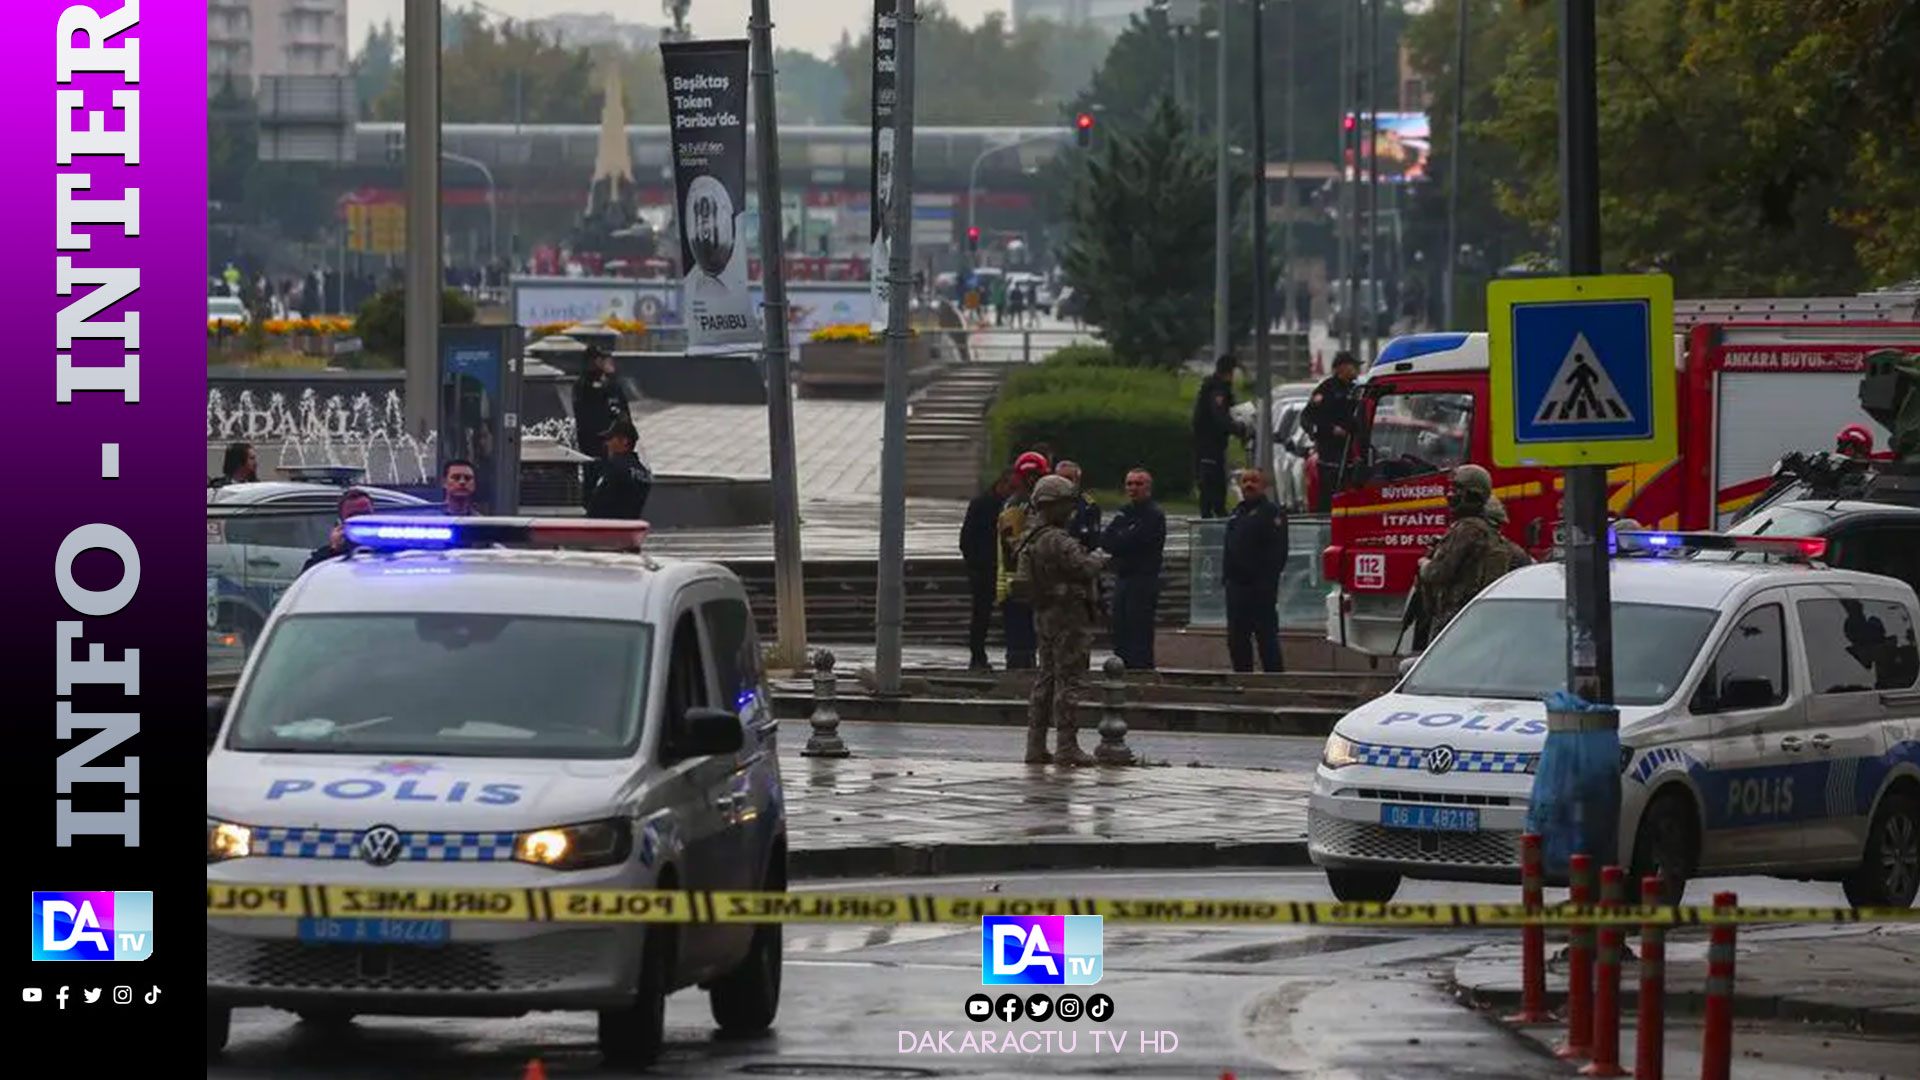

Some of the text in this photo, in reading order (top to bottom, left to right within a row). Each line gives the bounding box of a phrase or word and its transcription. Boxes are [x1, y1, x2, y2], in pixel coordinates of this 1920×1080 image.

[674, 74, 729, 92] Beşiktaş
[674, 95, 712, 109] Token
[1724, 352, 1778, 366] ANKARA
[1359, 558, 1379, 574] 112
